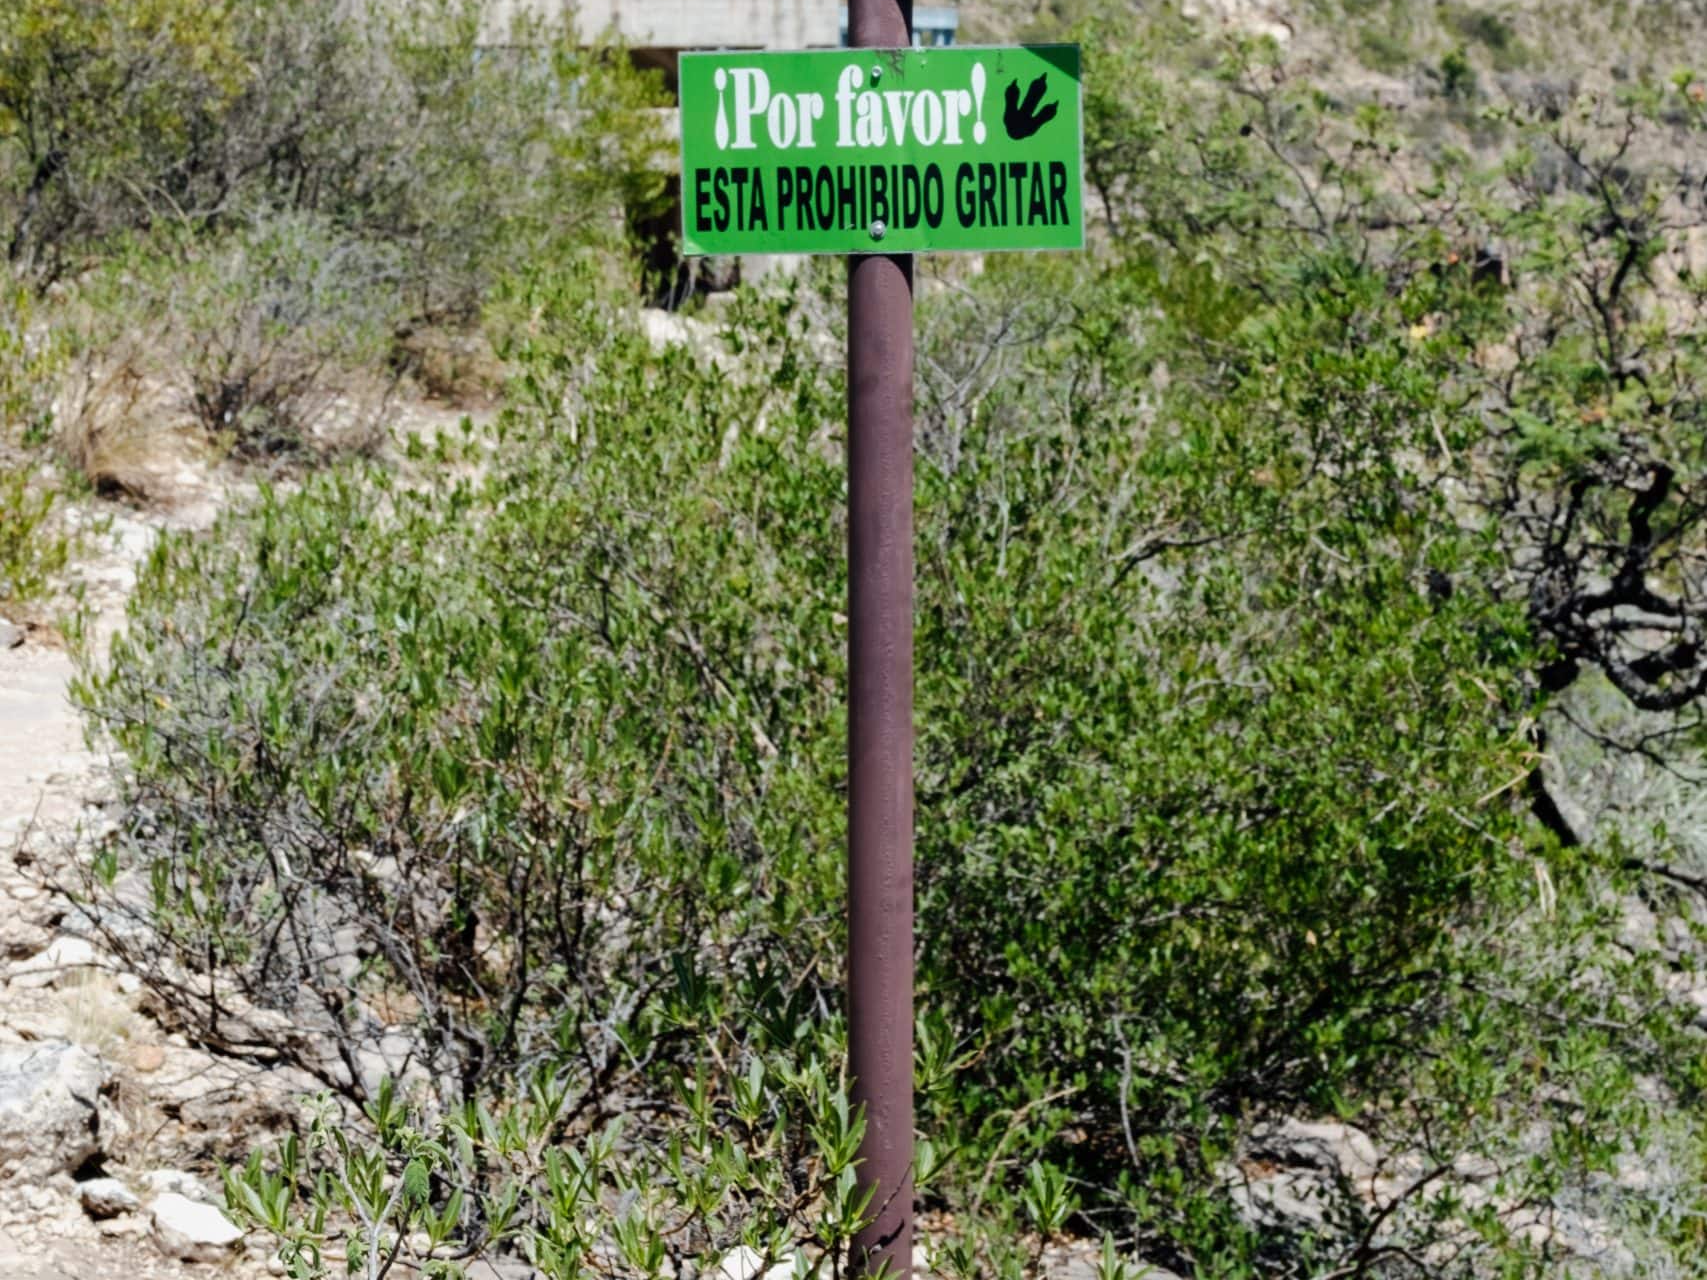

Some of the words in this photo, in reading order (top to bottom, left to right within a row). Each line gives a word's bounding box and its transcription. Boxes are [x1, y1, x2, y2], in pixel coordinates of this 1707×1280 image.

[713, 66, 824, 151] ¡Por
[835, 62, 987, 148] favor!
[695, 166, 769, 233] ESTA
[777, 162, 944, 231] PROHIBIDO
[955, 160, 1070, 229] GRITAR
